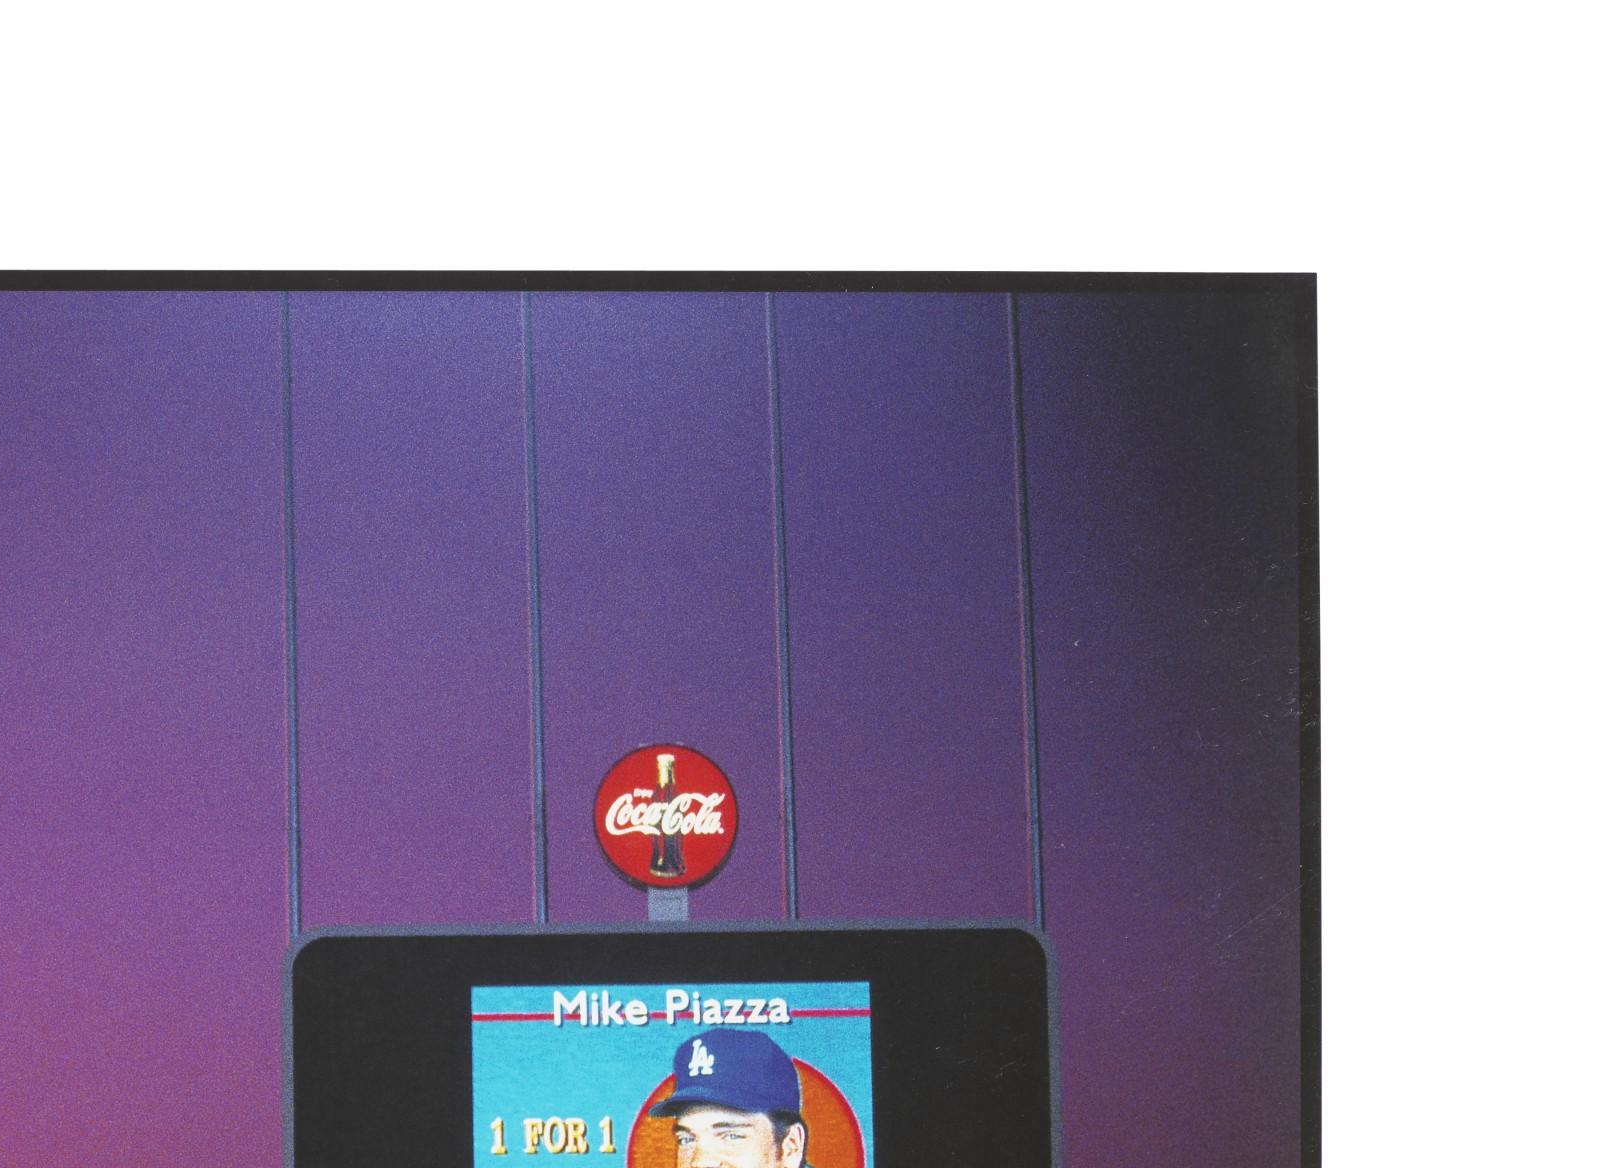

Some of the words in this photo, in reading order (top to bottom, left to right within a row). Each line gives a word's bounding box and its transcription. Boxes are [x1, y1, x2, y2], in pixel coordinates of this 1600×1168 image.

[552, 989, 649, 1027] Mike
[665, 988, 791, 1026] Piazza
[490, 1116, 508, 1155] 1
[523, 1115, 590, 1155] FOR
[599, 1115, 617, 1154] 1
